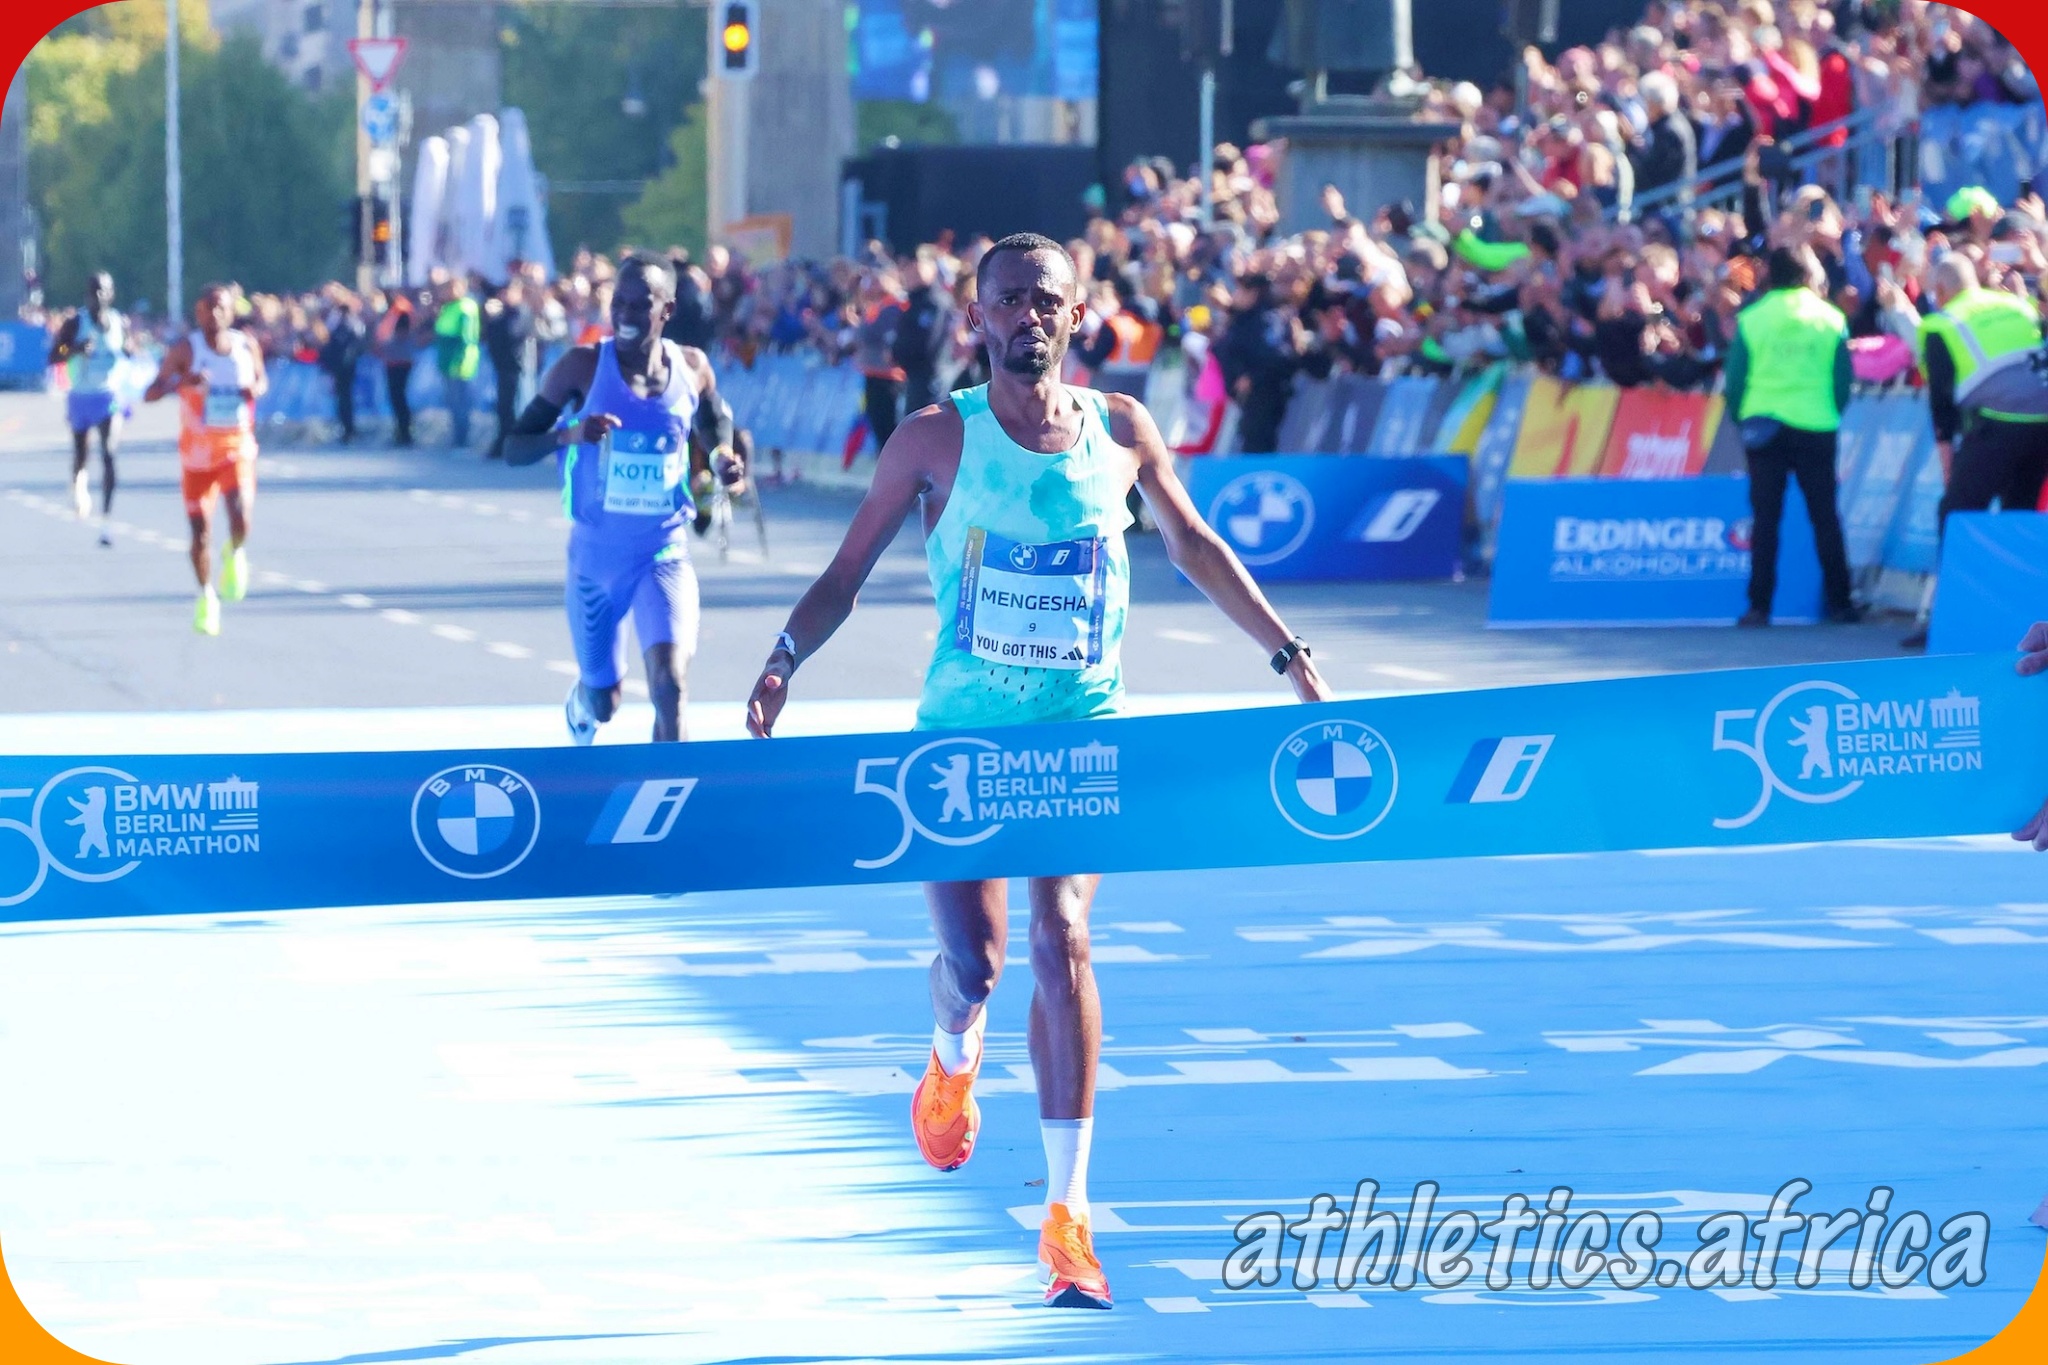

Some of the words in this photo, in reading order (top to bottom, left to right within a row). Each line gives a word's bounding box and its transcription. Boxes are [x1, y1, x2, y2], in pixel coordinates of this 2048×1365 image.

[614, 461, 674, 481] KOTU
[1554, 516, 1726, 554] ERDINGER
[981, 587, 1088, 612] MENGESHA
[1028, 622, 1037, 633] 9
[976, 634, 999, 652] YOU
[1002, 642, 1027, 657] GOT
[1029, 644, 1057, 660] THIS
[1835, 699, 1925, 732] BMW
[1286, 724, 1380, 758] BMW
[1712, 679, 1864, 829] 50
[1836, 731, 1928, 755] BERLIN
[976, 748, 1066, 777] BMW
[1838, 751, 1983, 778] MARATHON
[428, 768, 523, 799] BMW
[977, 775, 1067, 798] BERLIN
[114, 783, 204, 812] BMW
[853, 736, 1005, 869] 50
[978, 796, 1121, 822] MARATHON
[115, 812, 206, 835] BERLIN
[116, 833, 261, 858] MARATHON
